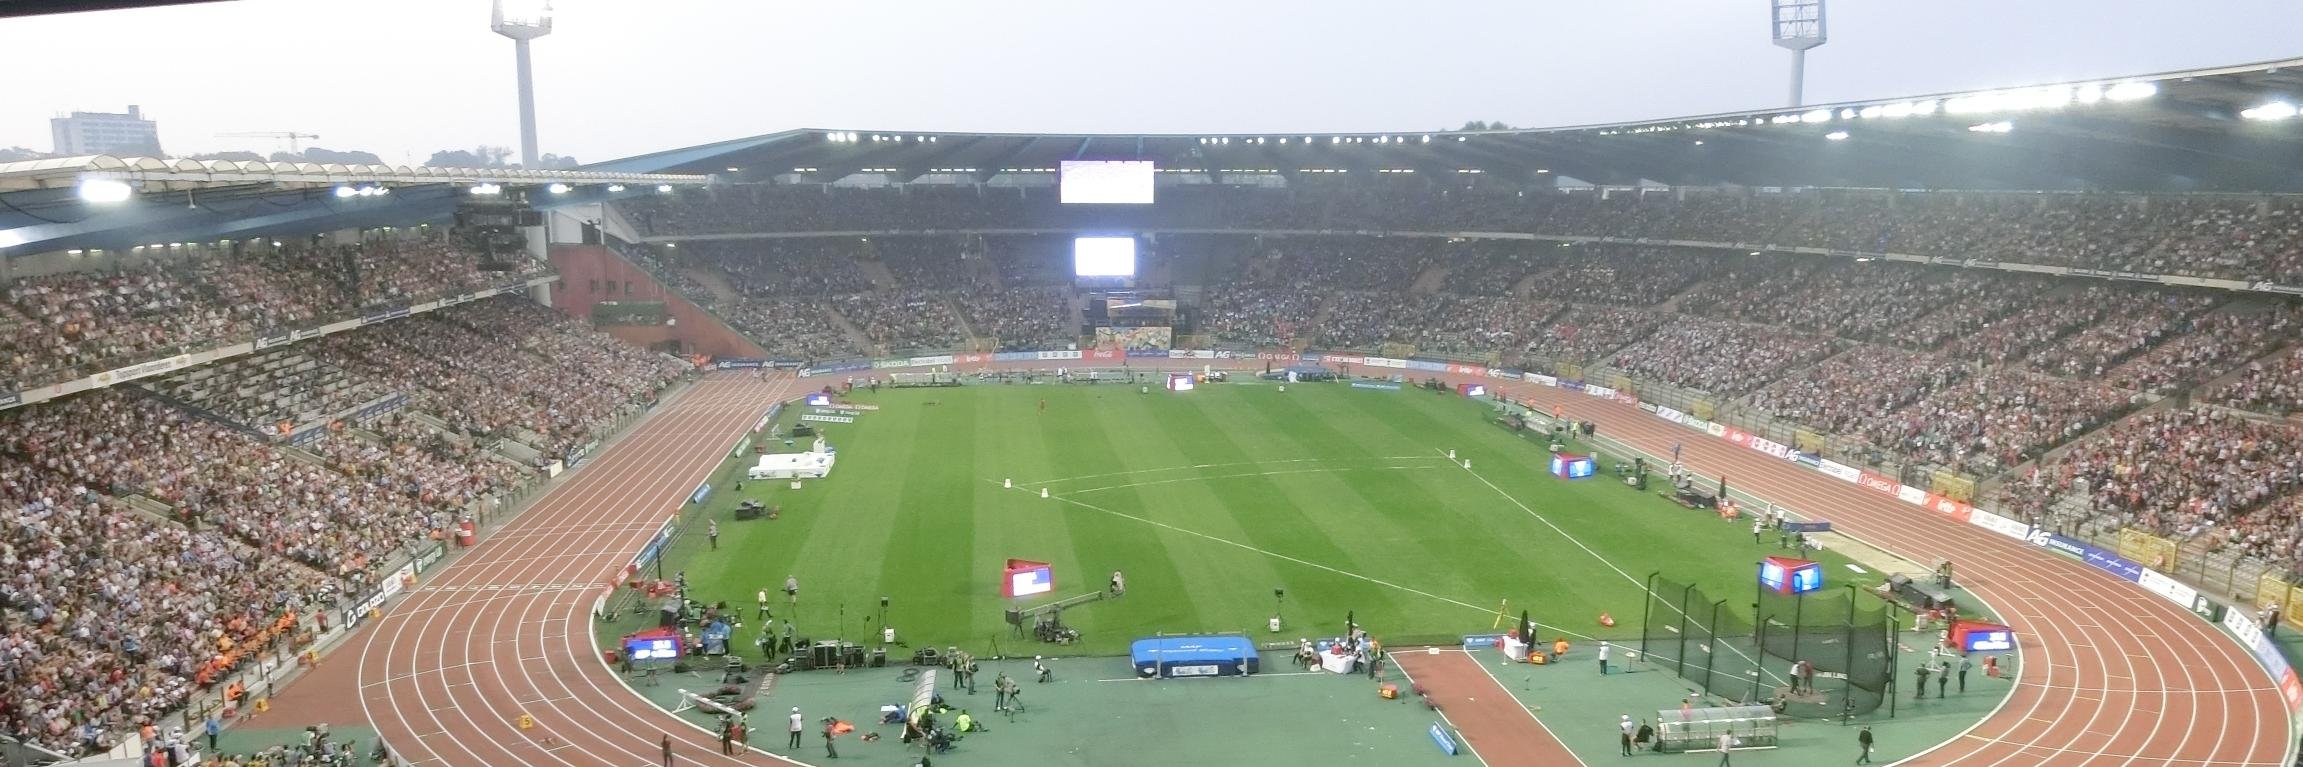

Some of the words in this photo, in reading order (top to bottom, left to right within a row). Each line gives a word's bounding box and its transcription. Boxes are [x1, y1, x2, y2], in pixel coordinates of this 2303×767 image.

[2252, 281, 2273, 291] AG
[256, 337, 268, 349] AG
[1214, 350, 1230, 358] AG
[761, 360, 774, 368] AG
[797, 367, 810, 378] AG
[1784, 448, 1801, 463] AG
[1866, 477, 1892, 493] OMEGA
[2026, 528, 2052, 547] AG
[2048, 538, 2085, 556] INSURANCE
